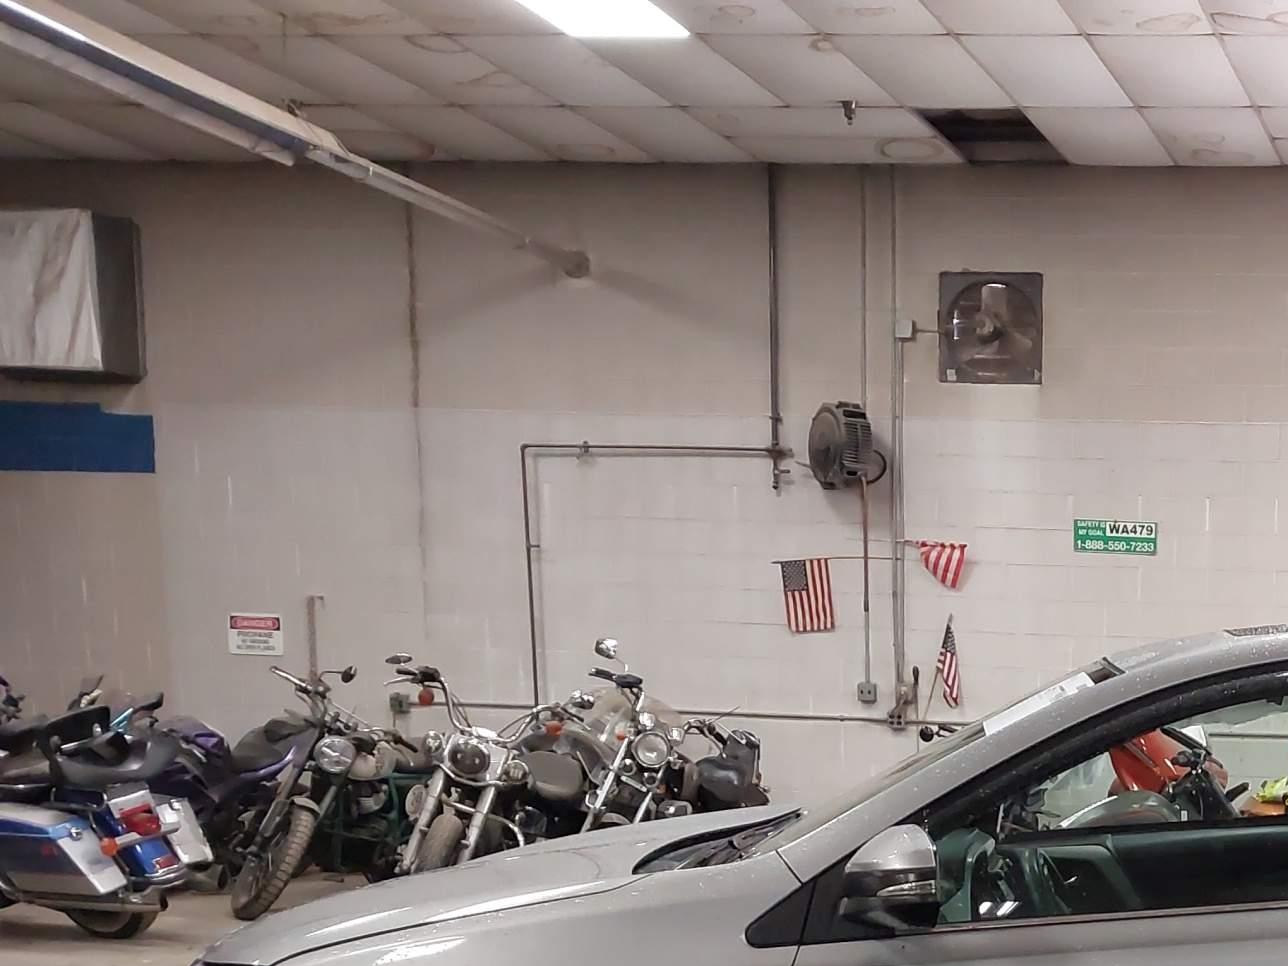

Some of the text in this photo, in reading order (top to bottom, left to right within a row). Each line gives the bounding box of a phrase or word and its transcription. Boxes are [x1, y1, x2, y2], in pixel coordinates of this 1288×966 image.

[1088, 529, 1104, 537] GOAL
[1108, 523, 1154, 536] WA479
[1077, 539, 1154, 552] 1-888-550-7233
